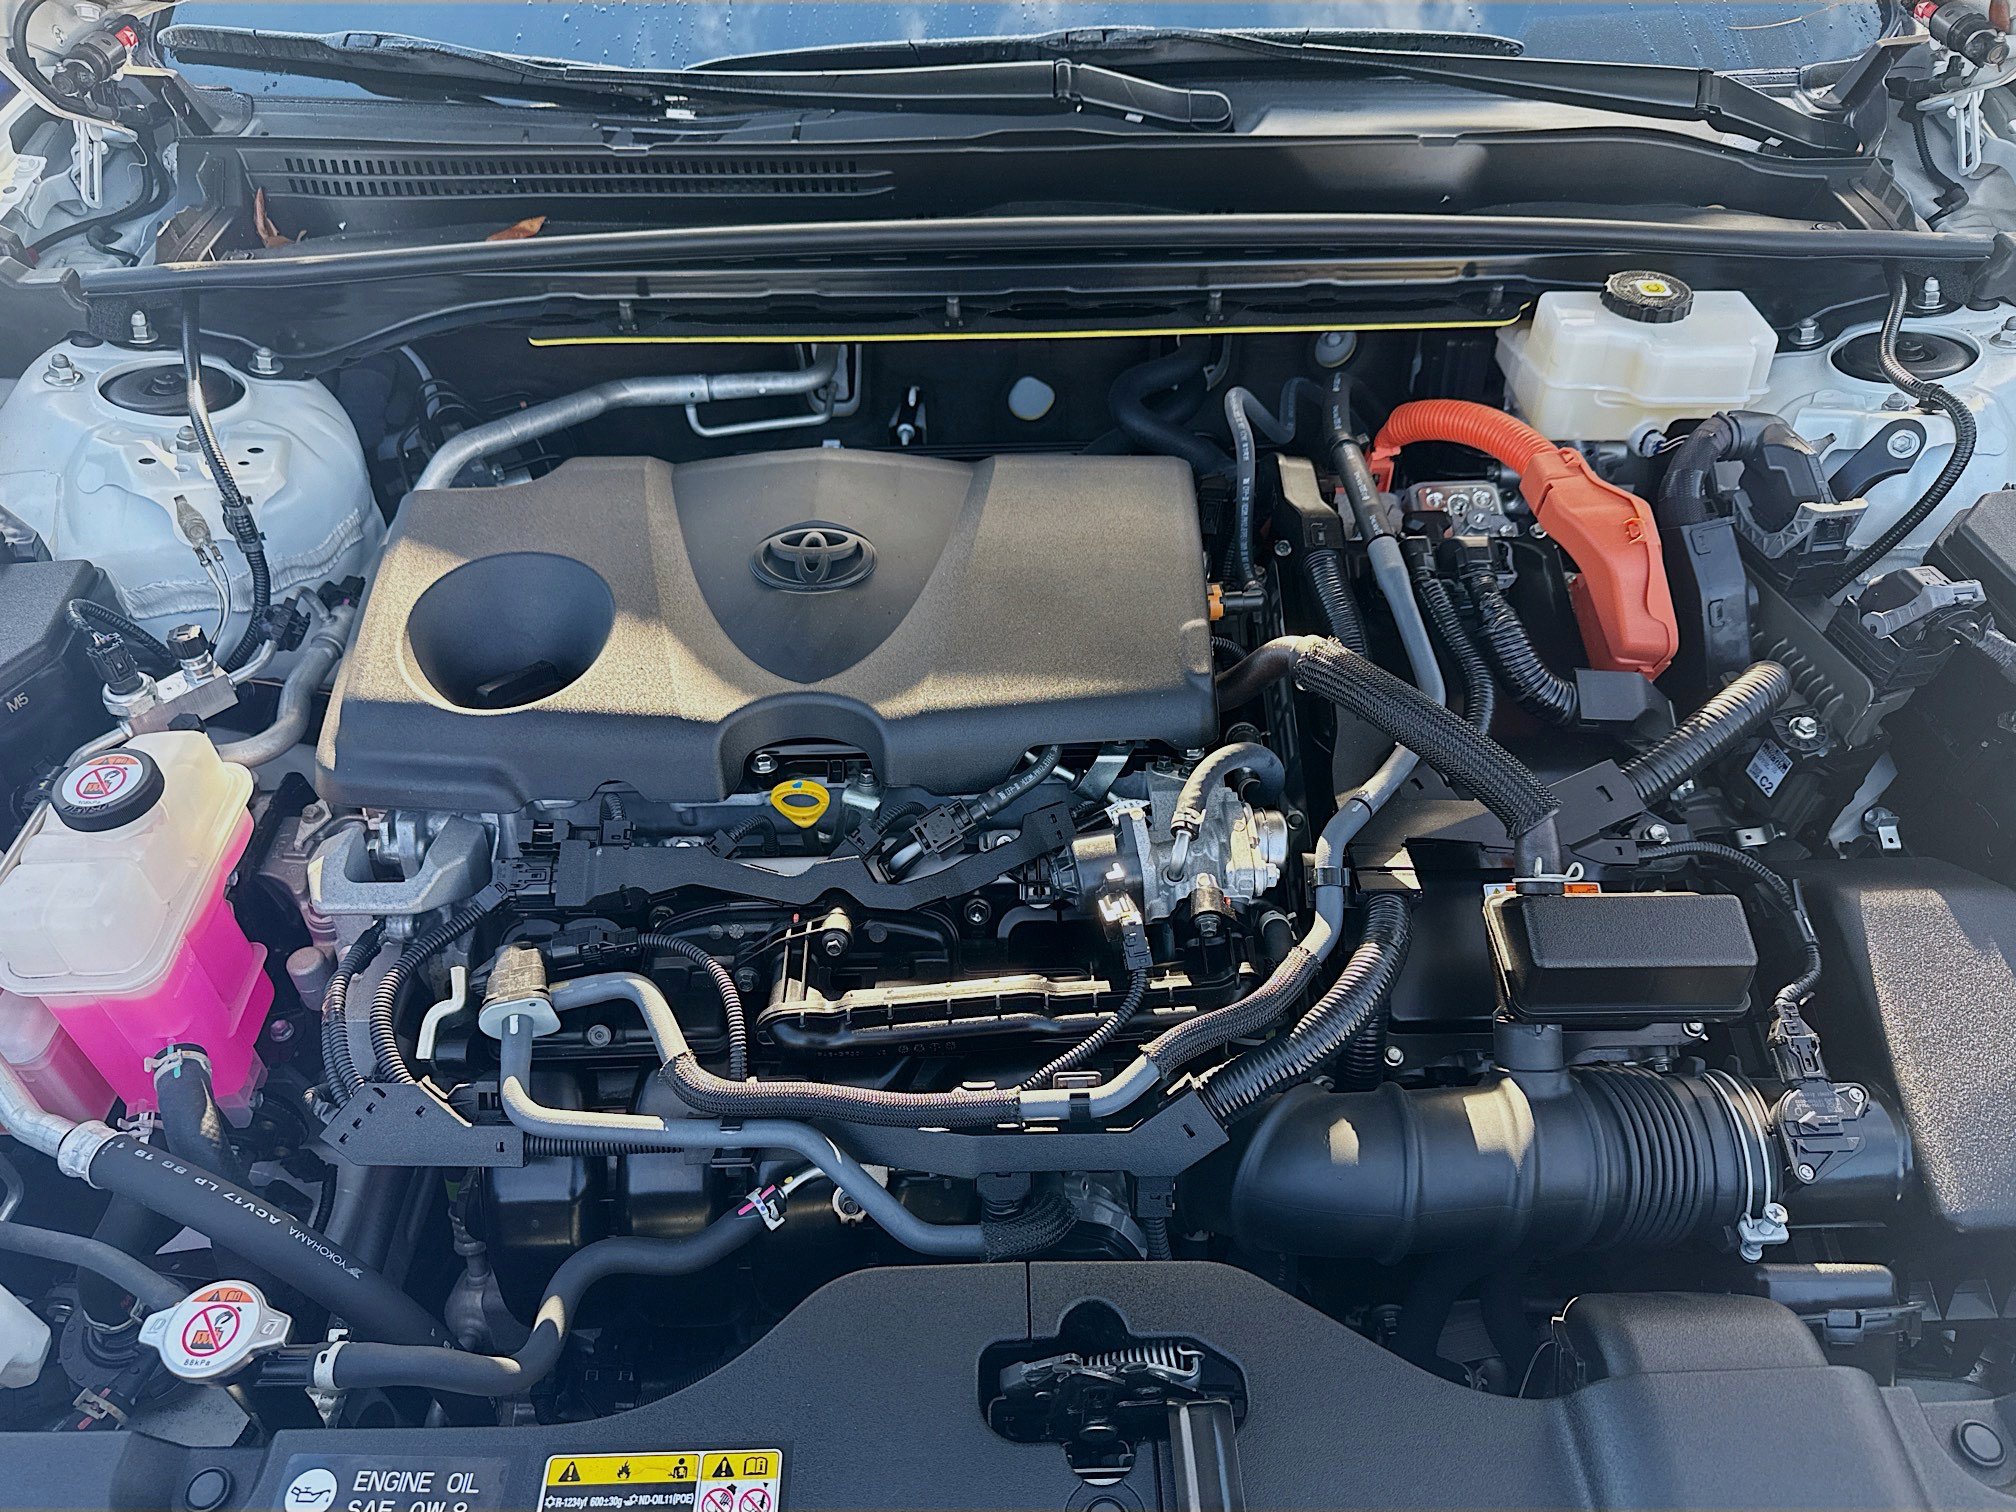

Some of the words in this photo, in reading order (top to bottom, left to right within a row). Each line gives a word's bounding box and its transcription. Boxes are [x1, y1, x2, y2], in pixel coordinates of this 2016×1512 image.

[6, 692, 29, 713] M5
[1760, 776, 1773, 793] C2
[194, 1177, 219, 1191] LP
[222, 1191, 282, 1225] ACV17
[289, 1225, 346, 1269] YOKOHAMA
[352, 1470, 435, 1493] ENGINE
[446, 1472, 480, 1494] OIL
